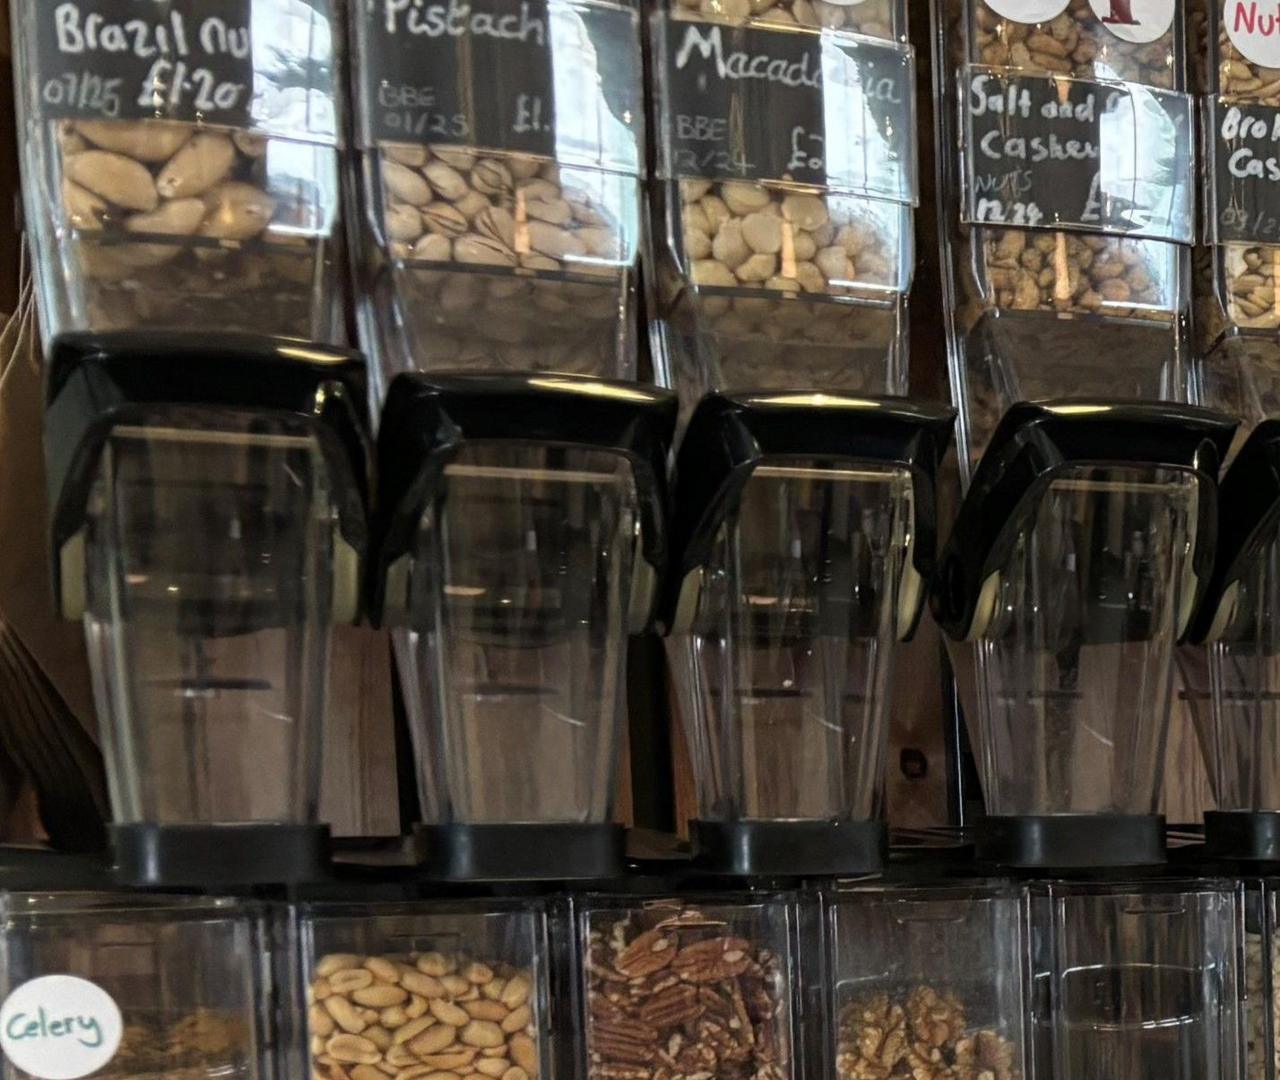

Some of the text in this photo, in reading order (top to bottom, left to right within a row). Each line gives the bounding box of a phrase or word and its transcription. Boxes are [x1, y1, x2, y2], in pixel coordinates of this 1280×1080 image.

[54, 3, 188, 54] Brazil
[970, 73, 1033, 118] Salt
[6, 1006, 104, 1049] Celery
